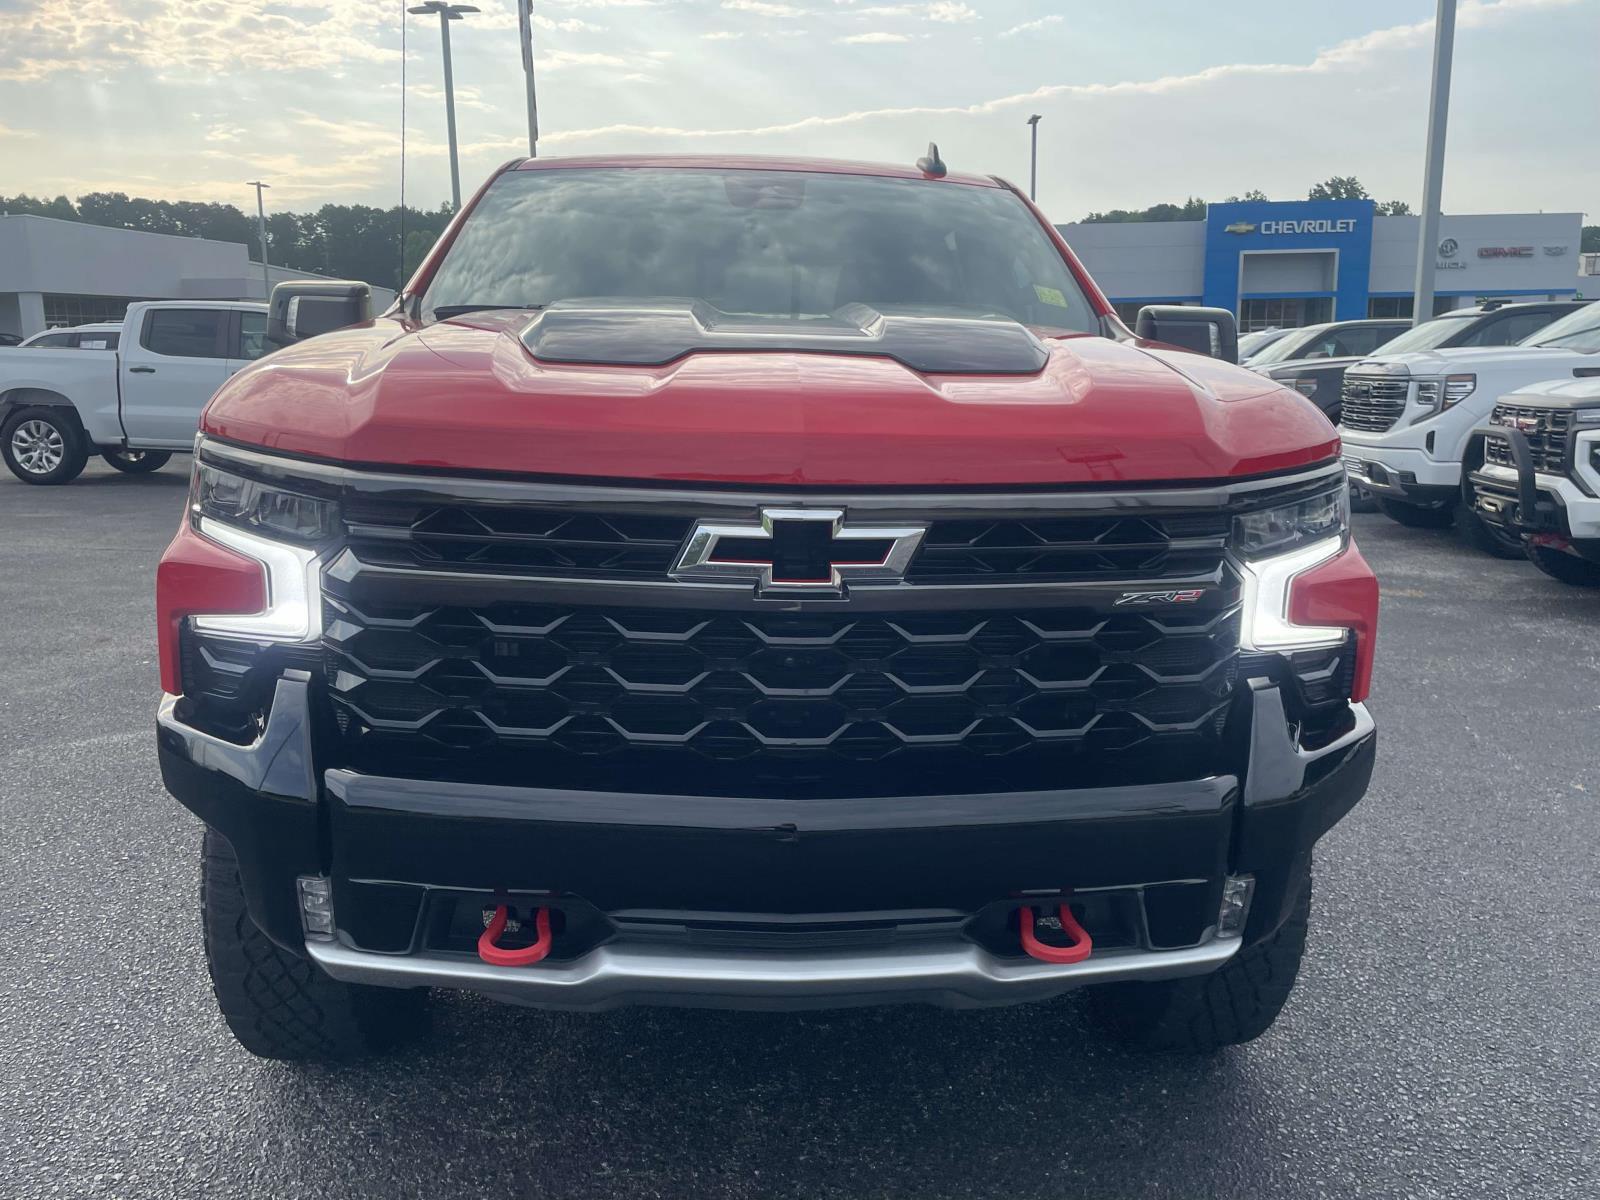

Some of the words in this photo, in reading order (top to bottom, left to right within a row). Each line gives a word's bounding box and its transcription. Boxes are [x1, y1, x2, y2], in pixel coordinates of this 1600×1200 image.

[1260, 219, 1357, 234] CHEVROLET
[1477, 246, 1535, 259] GMC
[1113, 588, 1206, 606] ZR2
